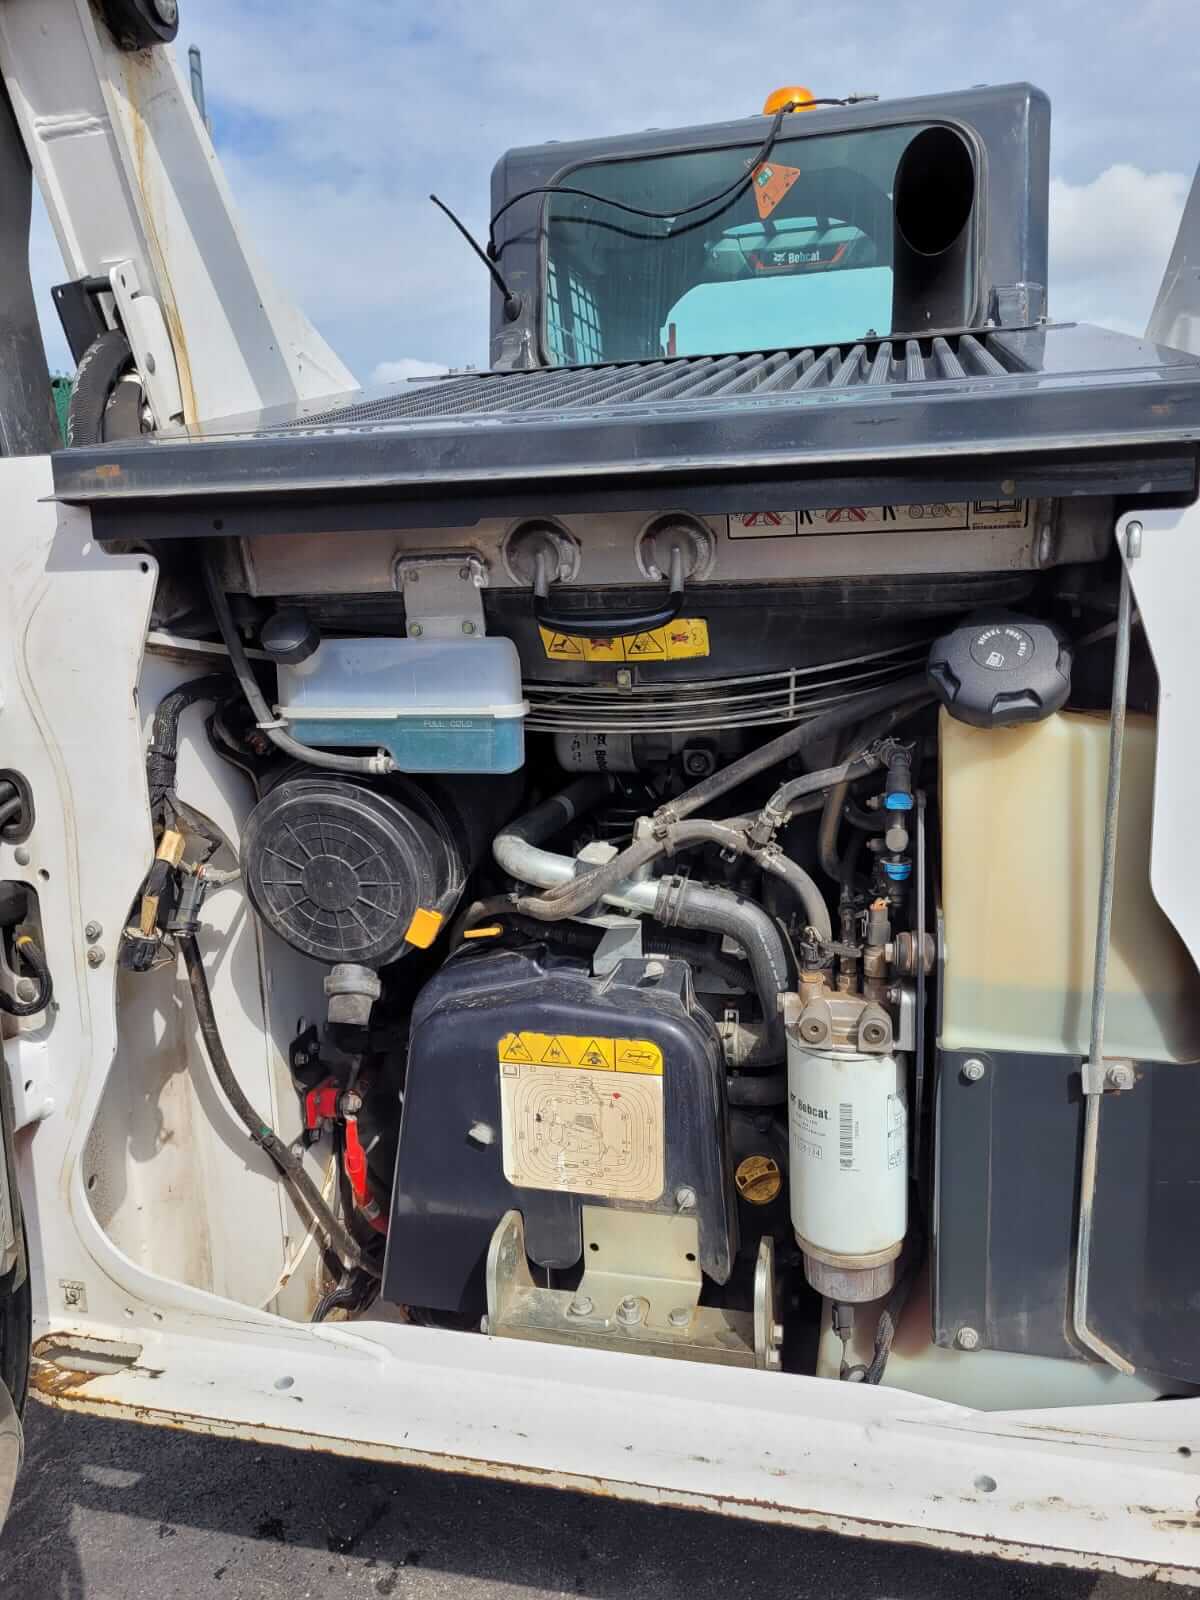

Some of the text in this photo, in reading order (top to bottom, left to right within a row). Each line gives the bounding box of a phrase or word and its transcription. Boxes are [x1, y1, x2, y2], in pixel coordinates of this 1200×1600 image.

[788, 250, 820, 264] Bobcat
[977, 626, 1000, 645] DIESEL
[1005, 628, 1022, 641] FUEL
[423, 719, 473, 728] FULL COLD
[798, 1098, 829, 1120] Bobcat
